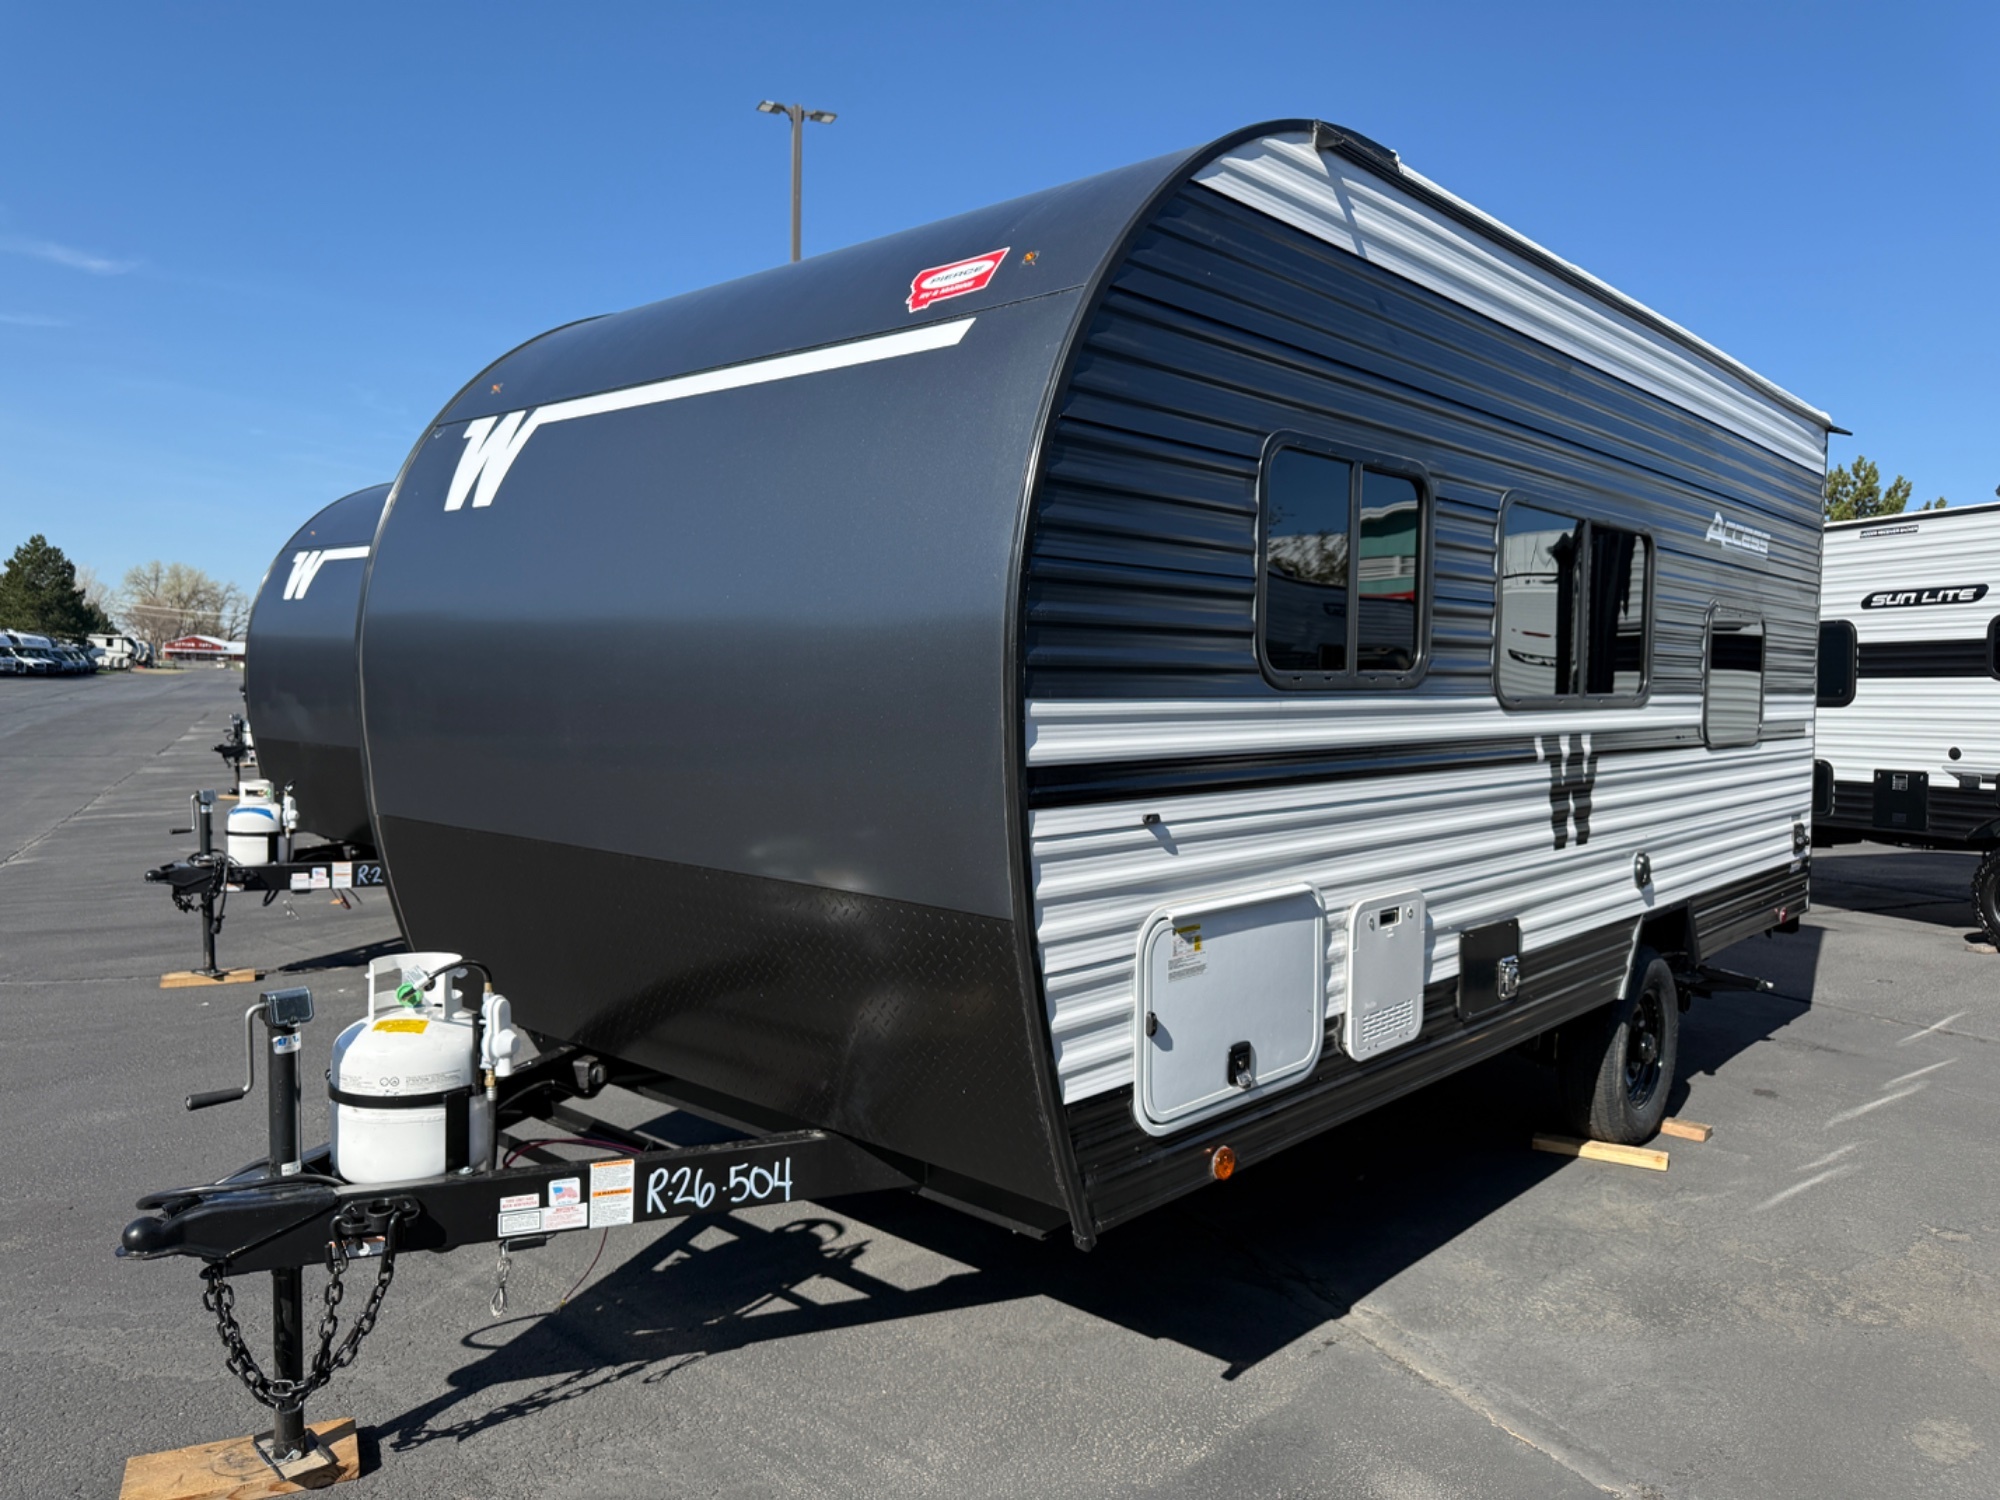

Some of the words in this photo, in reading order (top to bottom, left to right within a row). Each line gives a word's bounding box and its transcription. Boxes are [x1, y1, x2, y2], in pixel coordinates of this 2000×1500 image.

[930, 264, 985, 284] PIERCE
[1870, 592, 1917, 607] SUN
[1921, 587, 1977, 603] LITE
